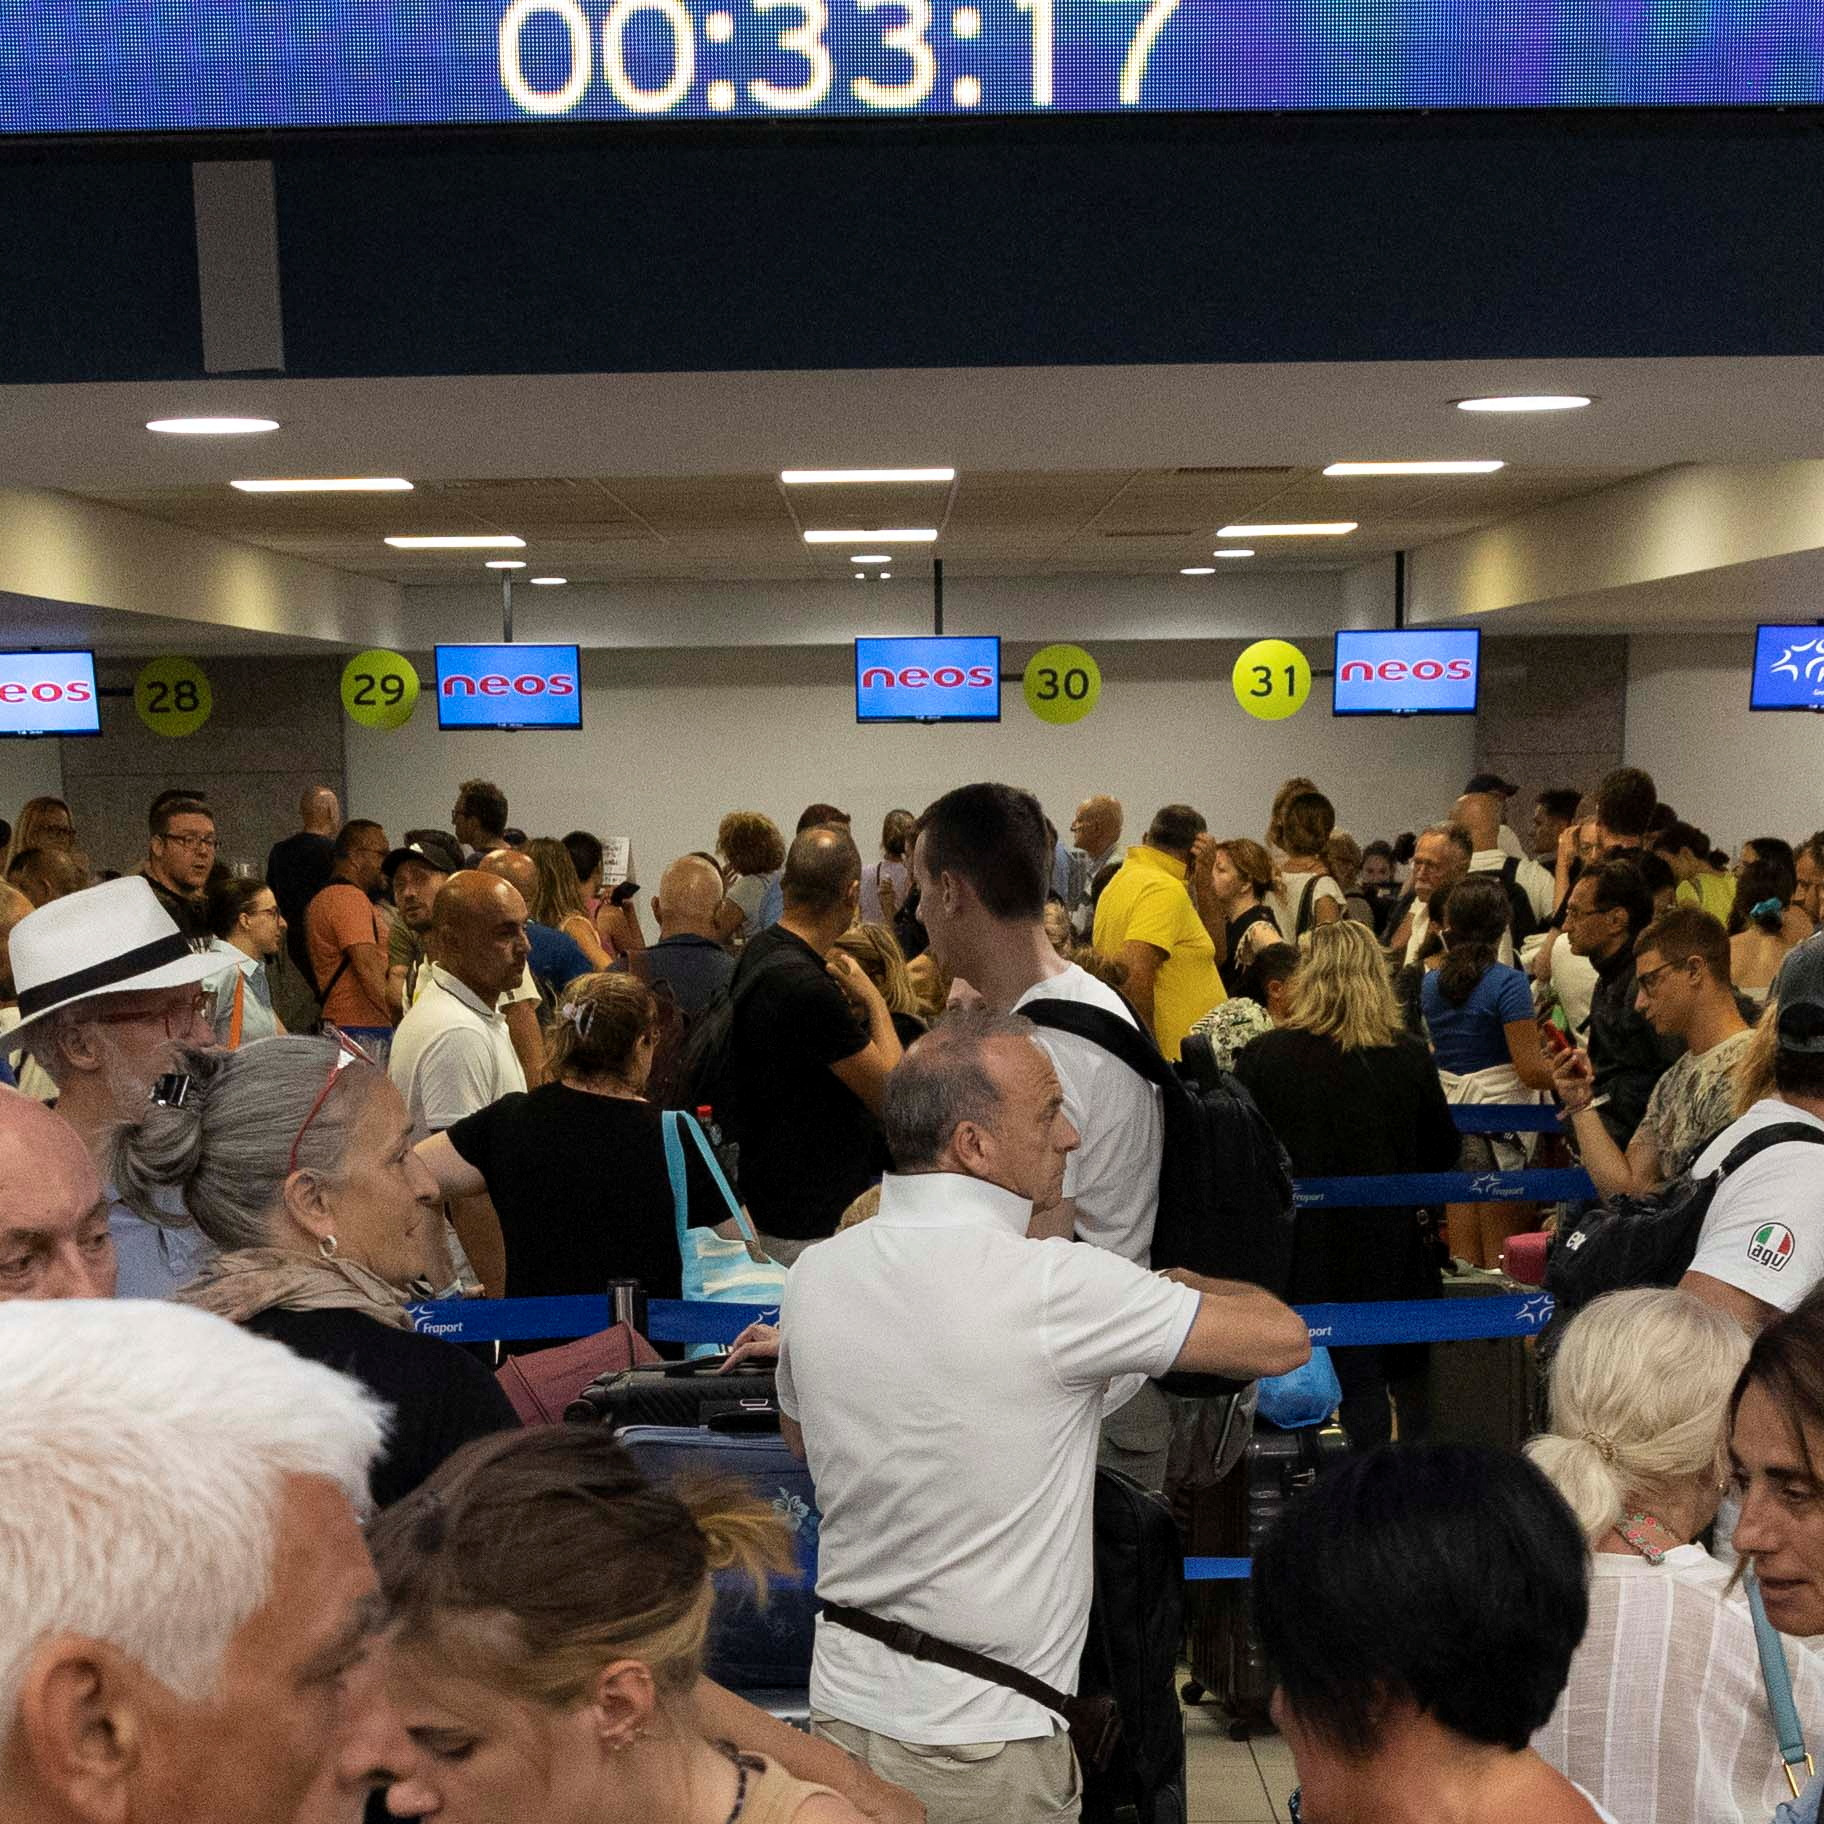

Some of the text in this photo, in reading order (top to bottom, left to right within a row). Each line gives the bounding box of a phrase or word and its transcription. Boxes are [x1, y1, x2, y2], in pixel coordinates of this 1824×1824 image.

[499, 0, 1177, 115] 00:33:17
[860, 664, 994, 690] neos
[1251, 664, 1296, 698] 31
[1339, 657, 1473, 683] neos
[146, 680, 200, 714] 28
[353, 673, 405, 706] 29
[442, 674, 575, 698] neos
[1036, 667, 1089, 701] 30
[1751, 1243, 1786, 1267] agv
[423, 1321, 464, 1336] Fraport
[1307, 1325, 1332, 1339] port
